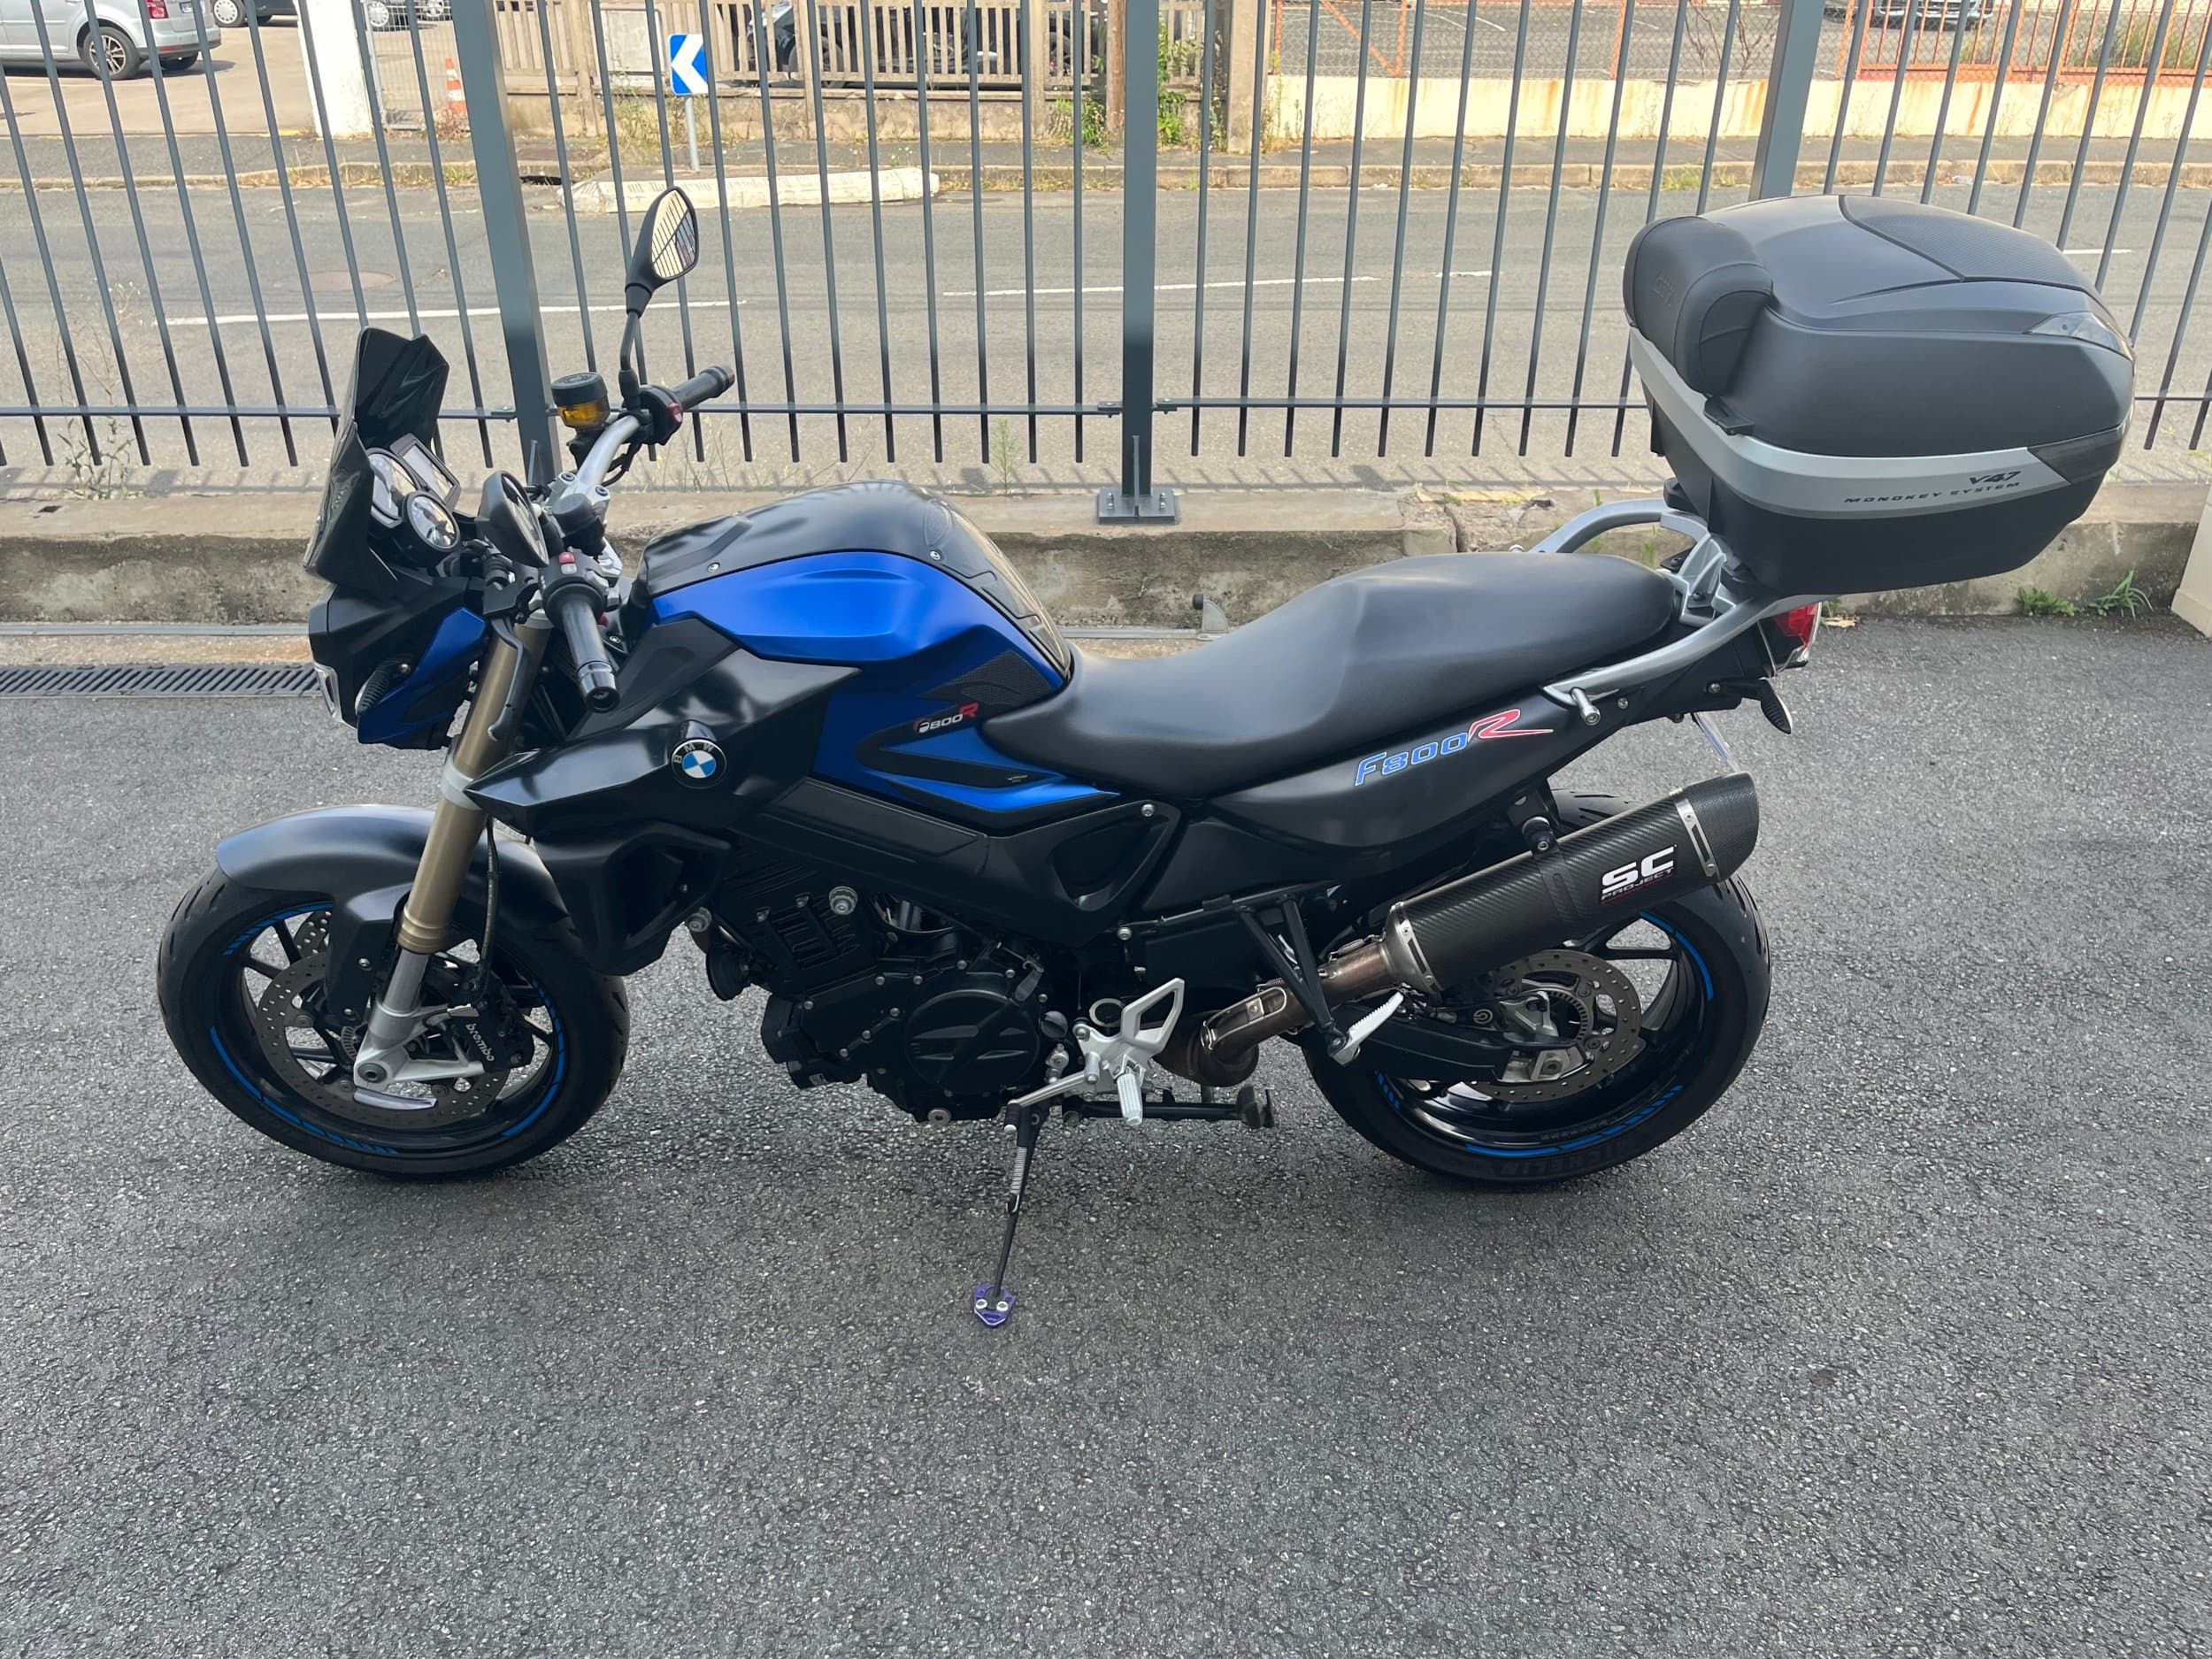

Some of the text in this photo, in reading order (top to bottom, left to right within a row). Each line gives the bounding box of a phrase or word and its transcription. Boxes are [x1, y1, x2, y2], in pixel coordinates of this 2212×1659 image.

[1843, 481, 2020, 503] MONOKEY SYSTEM
[1969, 471, 2022, 485] V47
[673, 742, 715, 764] BMW
[1355, 709, 1554, 786] F800R
[1602, 846, 1674, 894] SC
[465, 1023, 495, 1061] brembo
